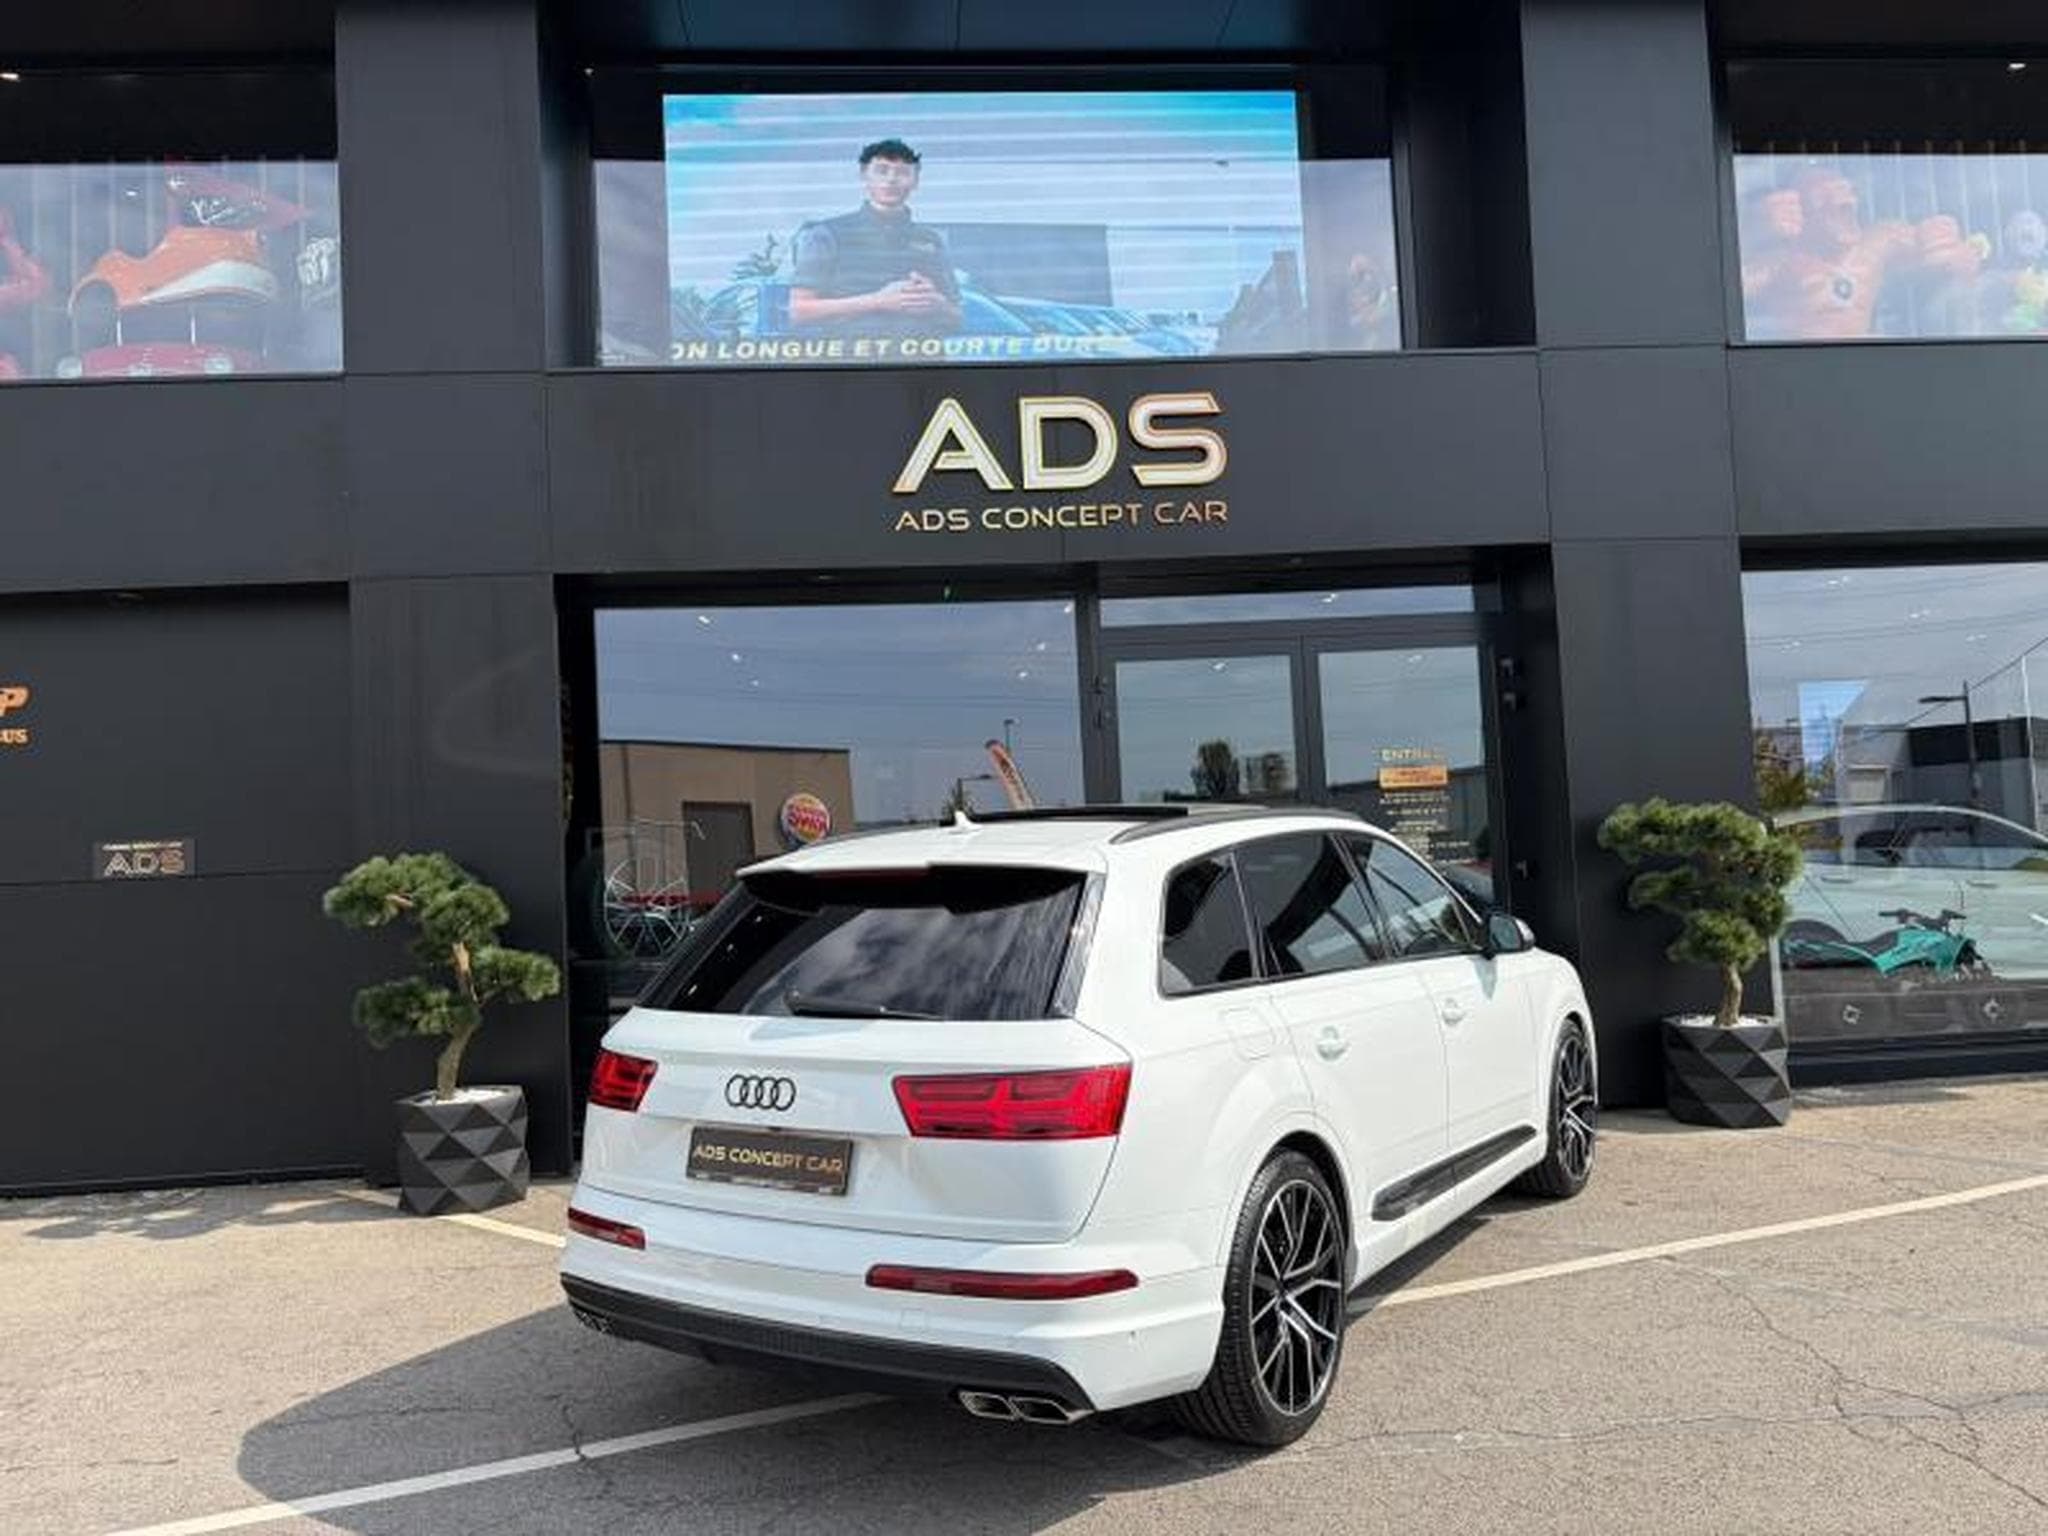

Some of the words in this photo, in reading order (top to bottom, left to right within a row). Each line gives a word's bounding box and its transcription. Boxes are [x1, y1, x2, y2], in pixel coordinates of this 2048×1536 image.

[718, 339, 843, 360] LONGUE
[854, 338, 889, 357] ET
[901, 336, 1023, 356] COURTE
[892, 391, 1228, 493] ADS
[894, 508, 970, 532] ADS
[981, 503, 1143, 530] CONCEPT
[1154, 500, 1229, 525] CAR
[103, 850, 186, 877] ADS
[692, 1145, 726, 1162] ADS
[729, 1147, 802, 1170] CONCEPT
[806, 1156, 843, 1174] CAR
